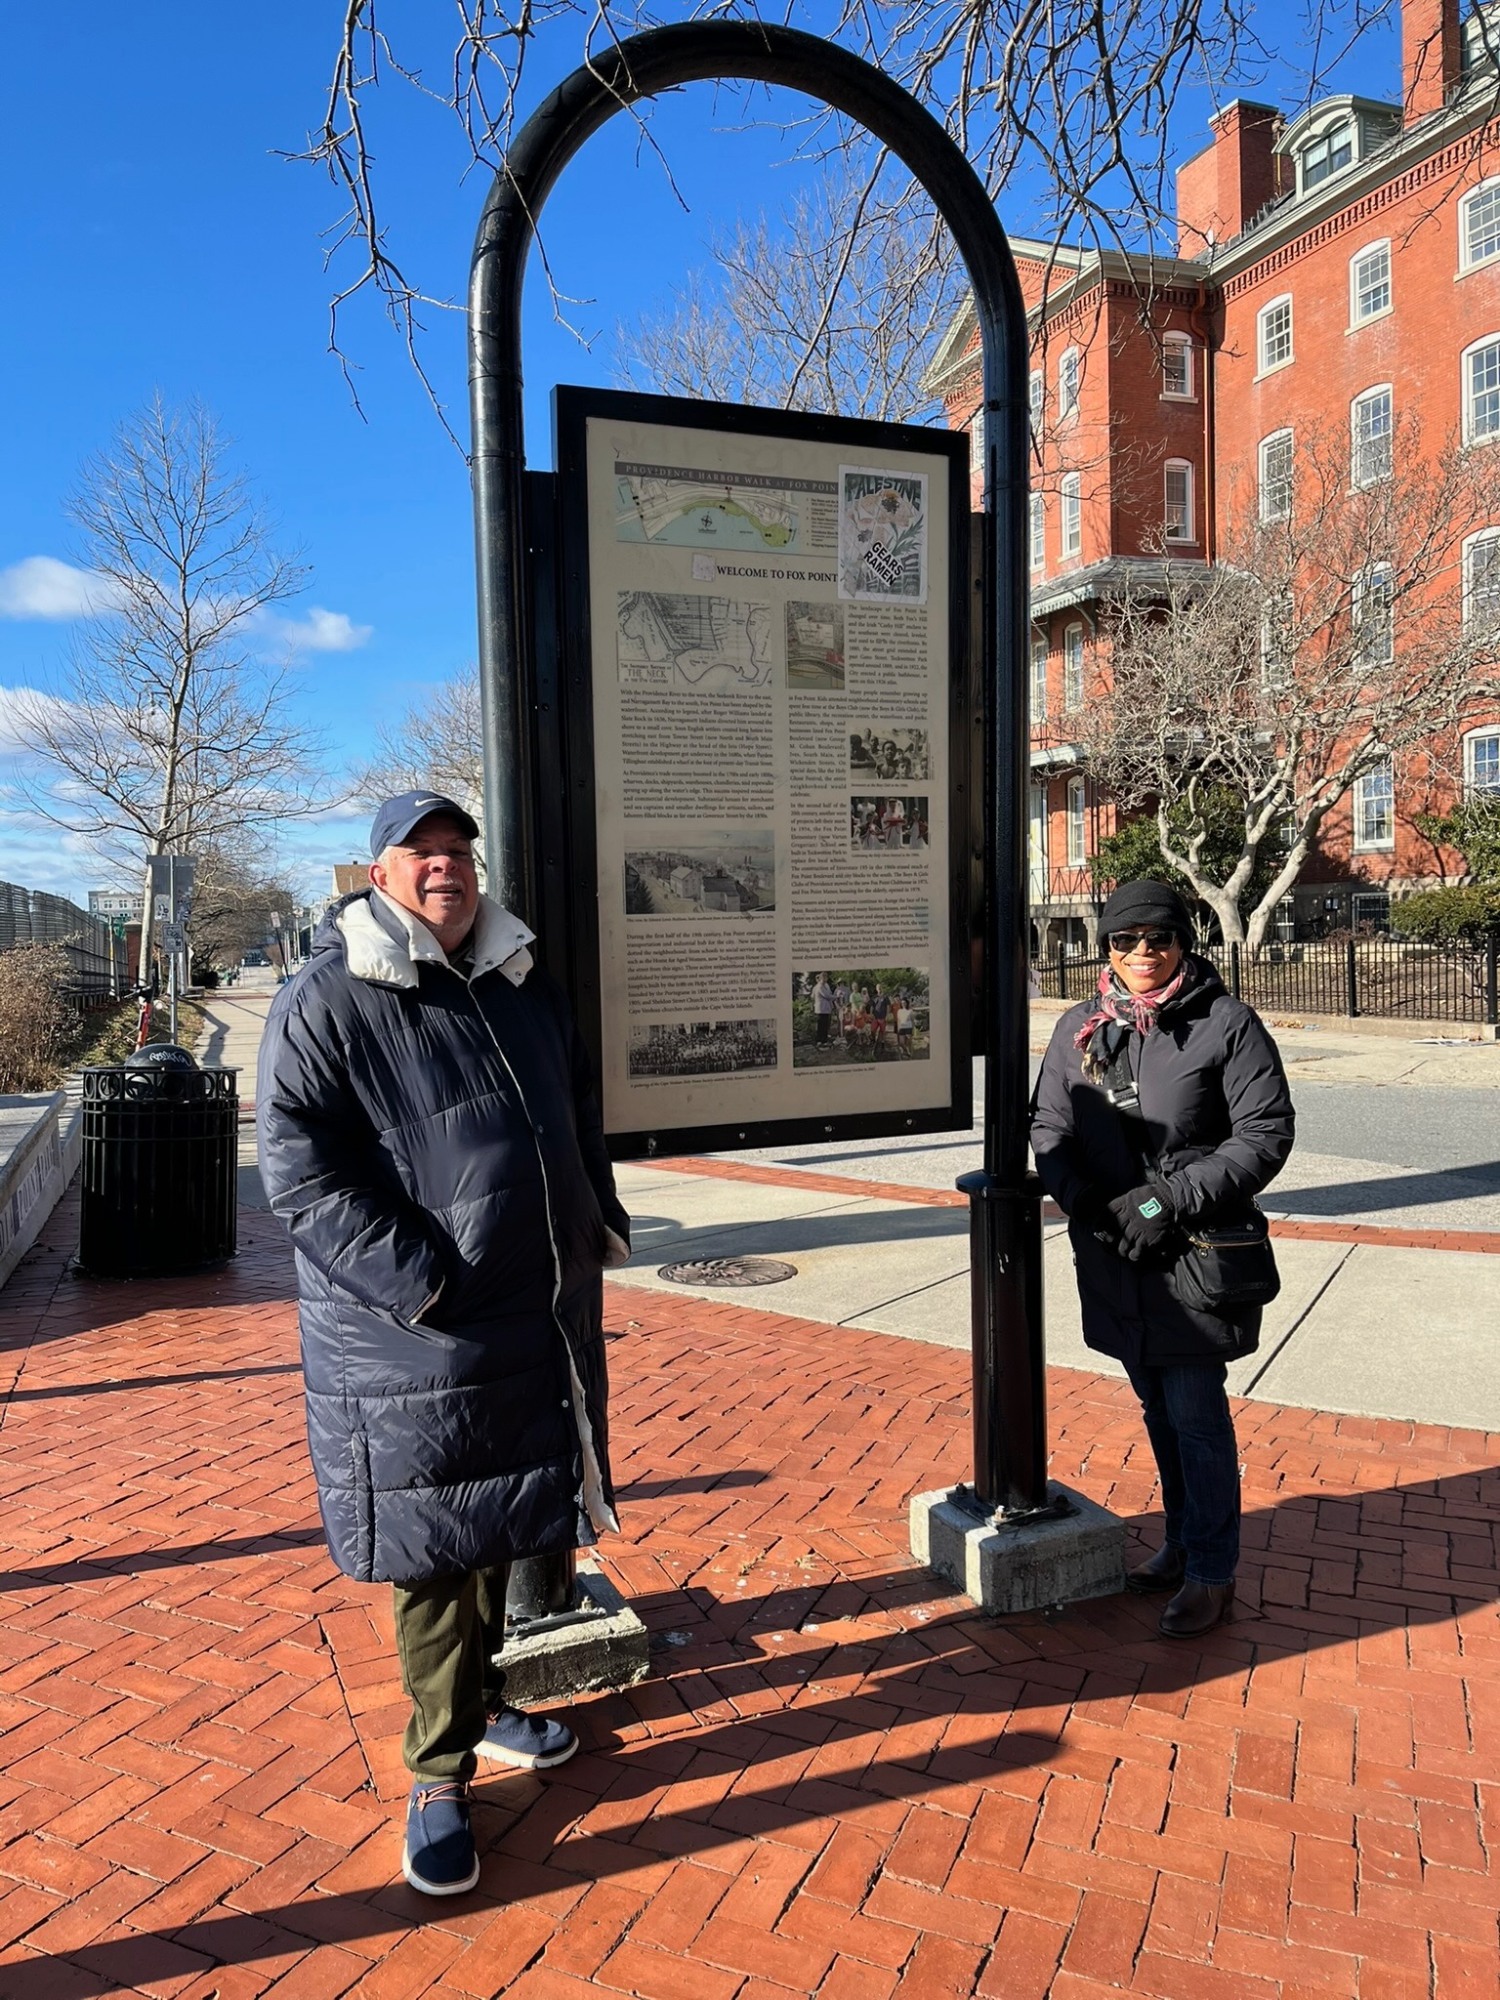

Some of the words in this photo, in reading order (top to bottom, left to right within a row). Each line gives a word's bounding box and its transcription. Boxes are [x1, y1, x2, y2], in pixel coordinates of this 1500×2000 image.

[626, 464, 694, 479] PROVIDENCE
[699, 469, 740, 483] HARBOR
[744, 476, 772, 487] WALK
[789, 480, 808, 490] FOX
[844, 473, 922, 512] PALESTINE
[717, 566, 768, 578] WELCOME
[770, 569, 784, 580] TO
[786, 570, 806, 581] FOX
[808, 572, 838, 582] POINT
[863, 550, 897, 587] RAMEN
[871, 541, 905, 577] GEARS
